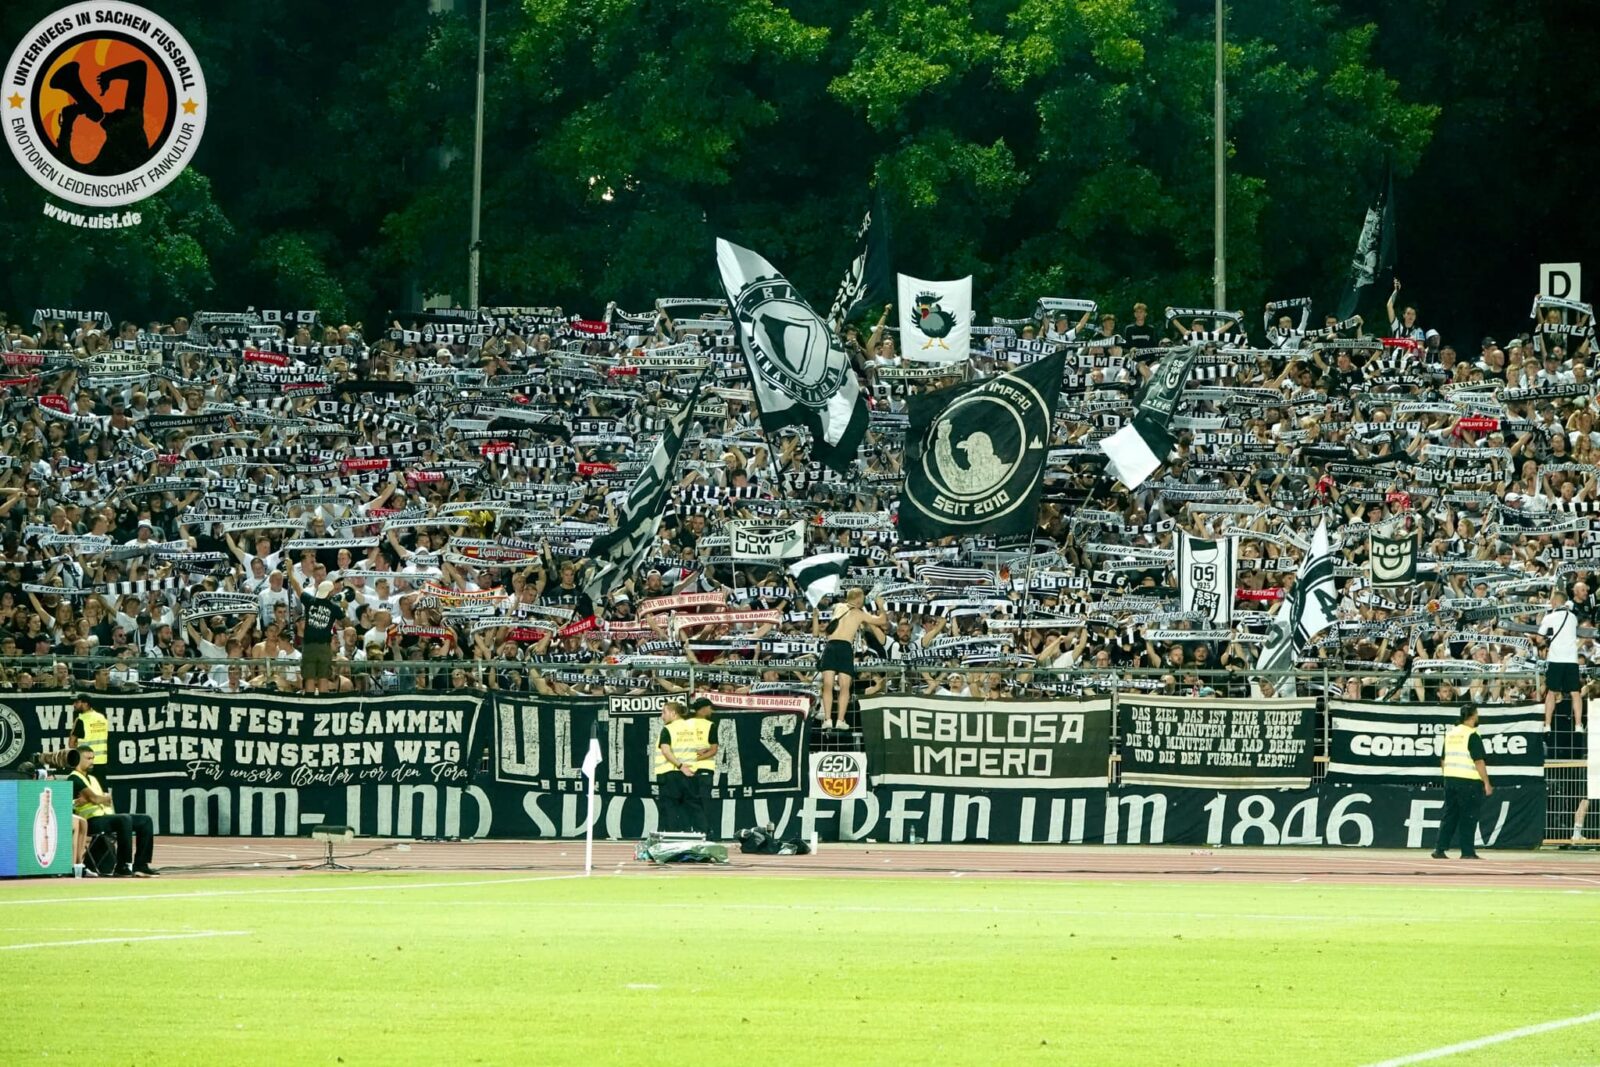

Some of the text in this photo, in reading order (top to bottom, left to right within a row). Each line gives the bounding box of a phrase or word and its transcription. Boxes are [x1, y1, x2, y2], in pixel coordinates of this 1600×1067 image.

[1548, 270, 1571, 299] D
[42, 309, 103, 321] ULMER
[435, 324, 492, 334] ULME
[408, 333, 466, 343] 1846
[90, 364, 107, 372] SSV
[109, 364, 130, 372] ULM
[257, 374, 278, 383] SSV
[304, 374, 327, 382] 1846
[988, 383, 1033, 411] IMPERO
[1510, 384, 1577, 398] SPATZEN
[150, 419, 193, 427] GEMEINSAM
[361, 442, 427, 456] 1846
[932, 489, 1010, 515] SEIT 2010
[751, 520, 773, 528] ULM
[1500, 525, 1543, 533] GEMEINSAM
[735, 529, 797, 544] POWER
[735, 544, 771, 555] ULM
[1197, 590, 1219, 601] SSV
[1195, 597, 1217, 609] 1846
[1466, 606, 1523, 620] SUPPORTERS
[36, 705, 76, 731] WI
[105, 702, 219, 734] HALTEN
[230, 707, 303, 737] FEST
[314, 710, 463, 736] ZUSAMMEN
[1132, 707, 1303, 726] DAS ZIEL DAS IST EINE KURVE
[883, 709, 1085, 744] NEBULOSA
[1135, 720, 1294, 740] DIE 90 MINUTEN LANG BEBT
[1126, 733, 1306, 754] DIE 90 MINUTEN AM RAD DREHT
[119, 735, 461, 768] GEHEN UNSEREN WEG
[1135, 749, 1154, 763] UND
[1159, 750, 1175, 764] DIE
[1181, 751, 1202, 765] DEN
[1256, 753, 1296, 768] LEBT!!!
[914, 745, 1053, 777] IMPERO
[187, 761, 223, 781] Für
[230, 767, 283, 783] unsere
[291, 764, 353, 787] Brüder
[359, 767, 386, 780] vor
[391, 763, 421, 782] den
[1204, 792, 1374, 847] 1846
